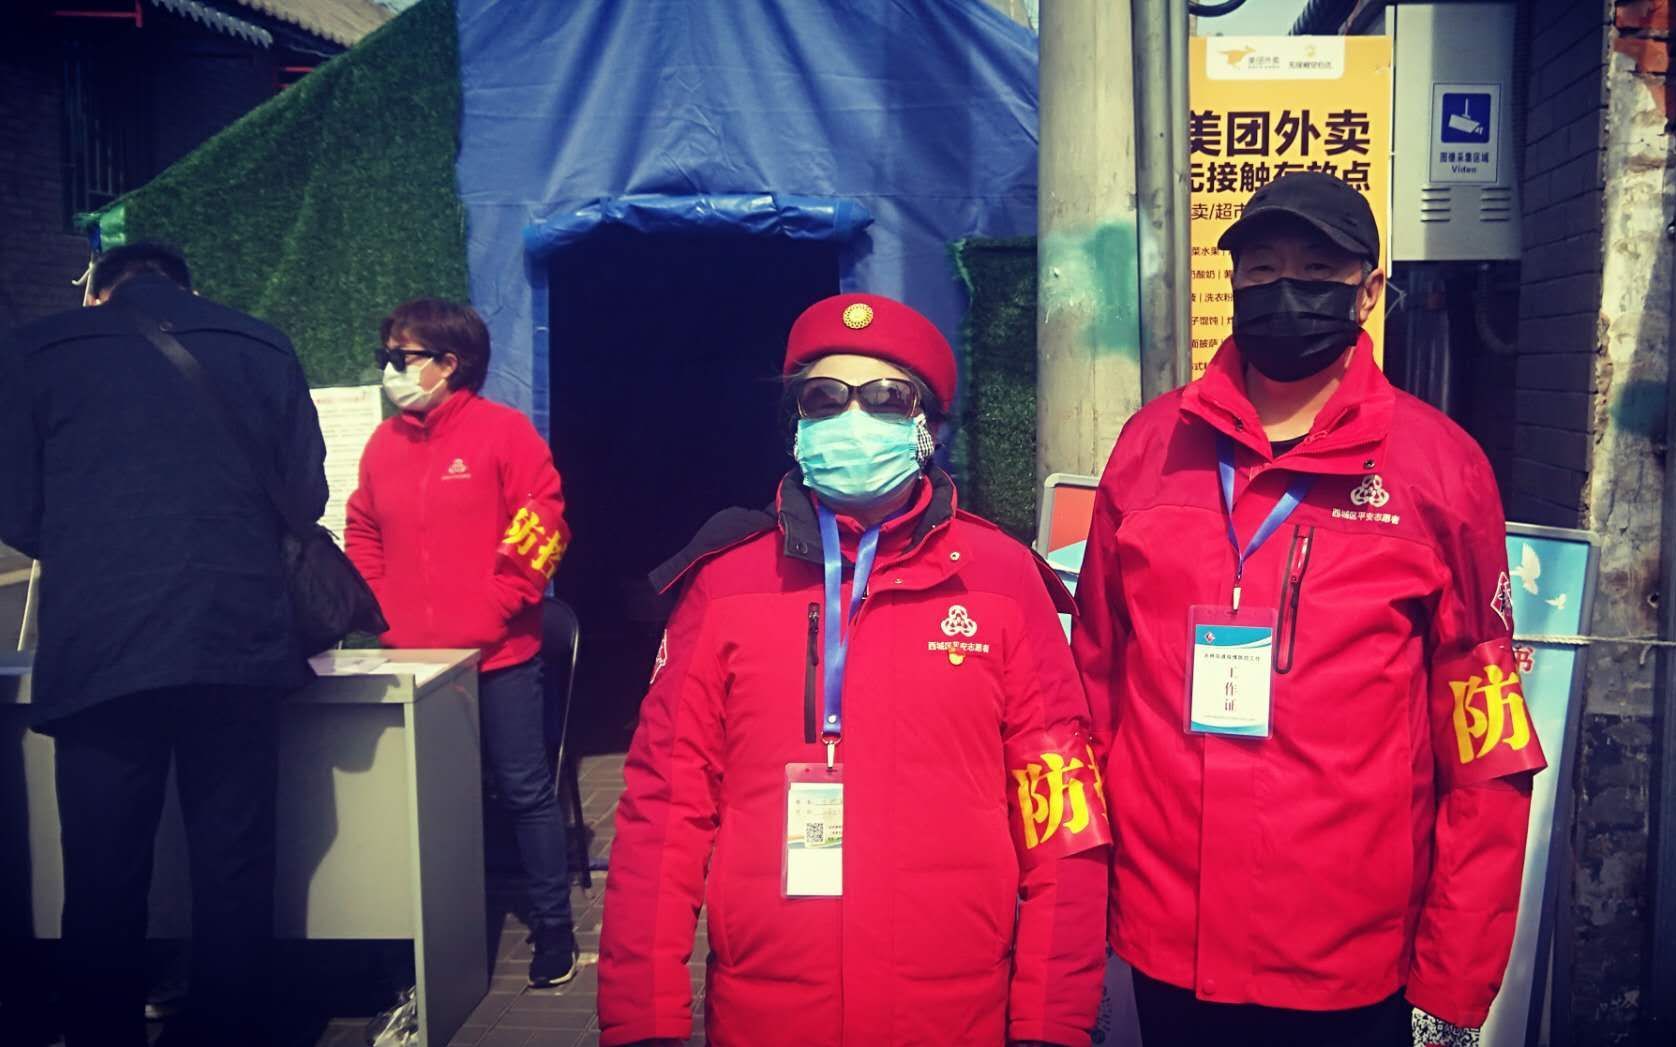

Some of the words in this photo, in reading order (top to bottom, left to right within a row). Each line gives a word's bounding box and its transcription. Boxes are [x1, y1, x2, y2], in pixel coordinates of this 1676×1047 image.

[1190, 110, 1370, 157] 美团外卖
[1451, 165, 1477, 174] Video
[1448, 664, 1531, 765] 防
